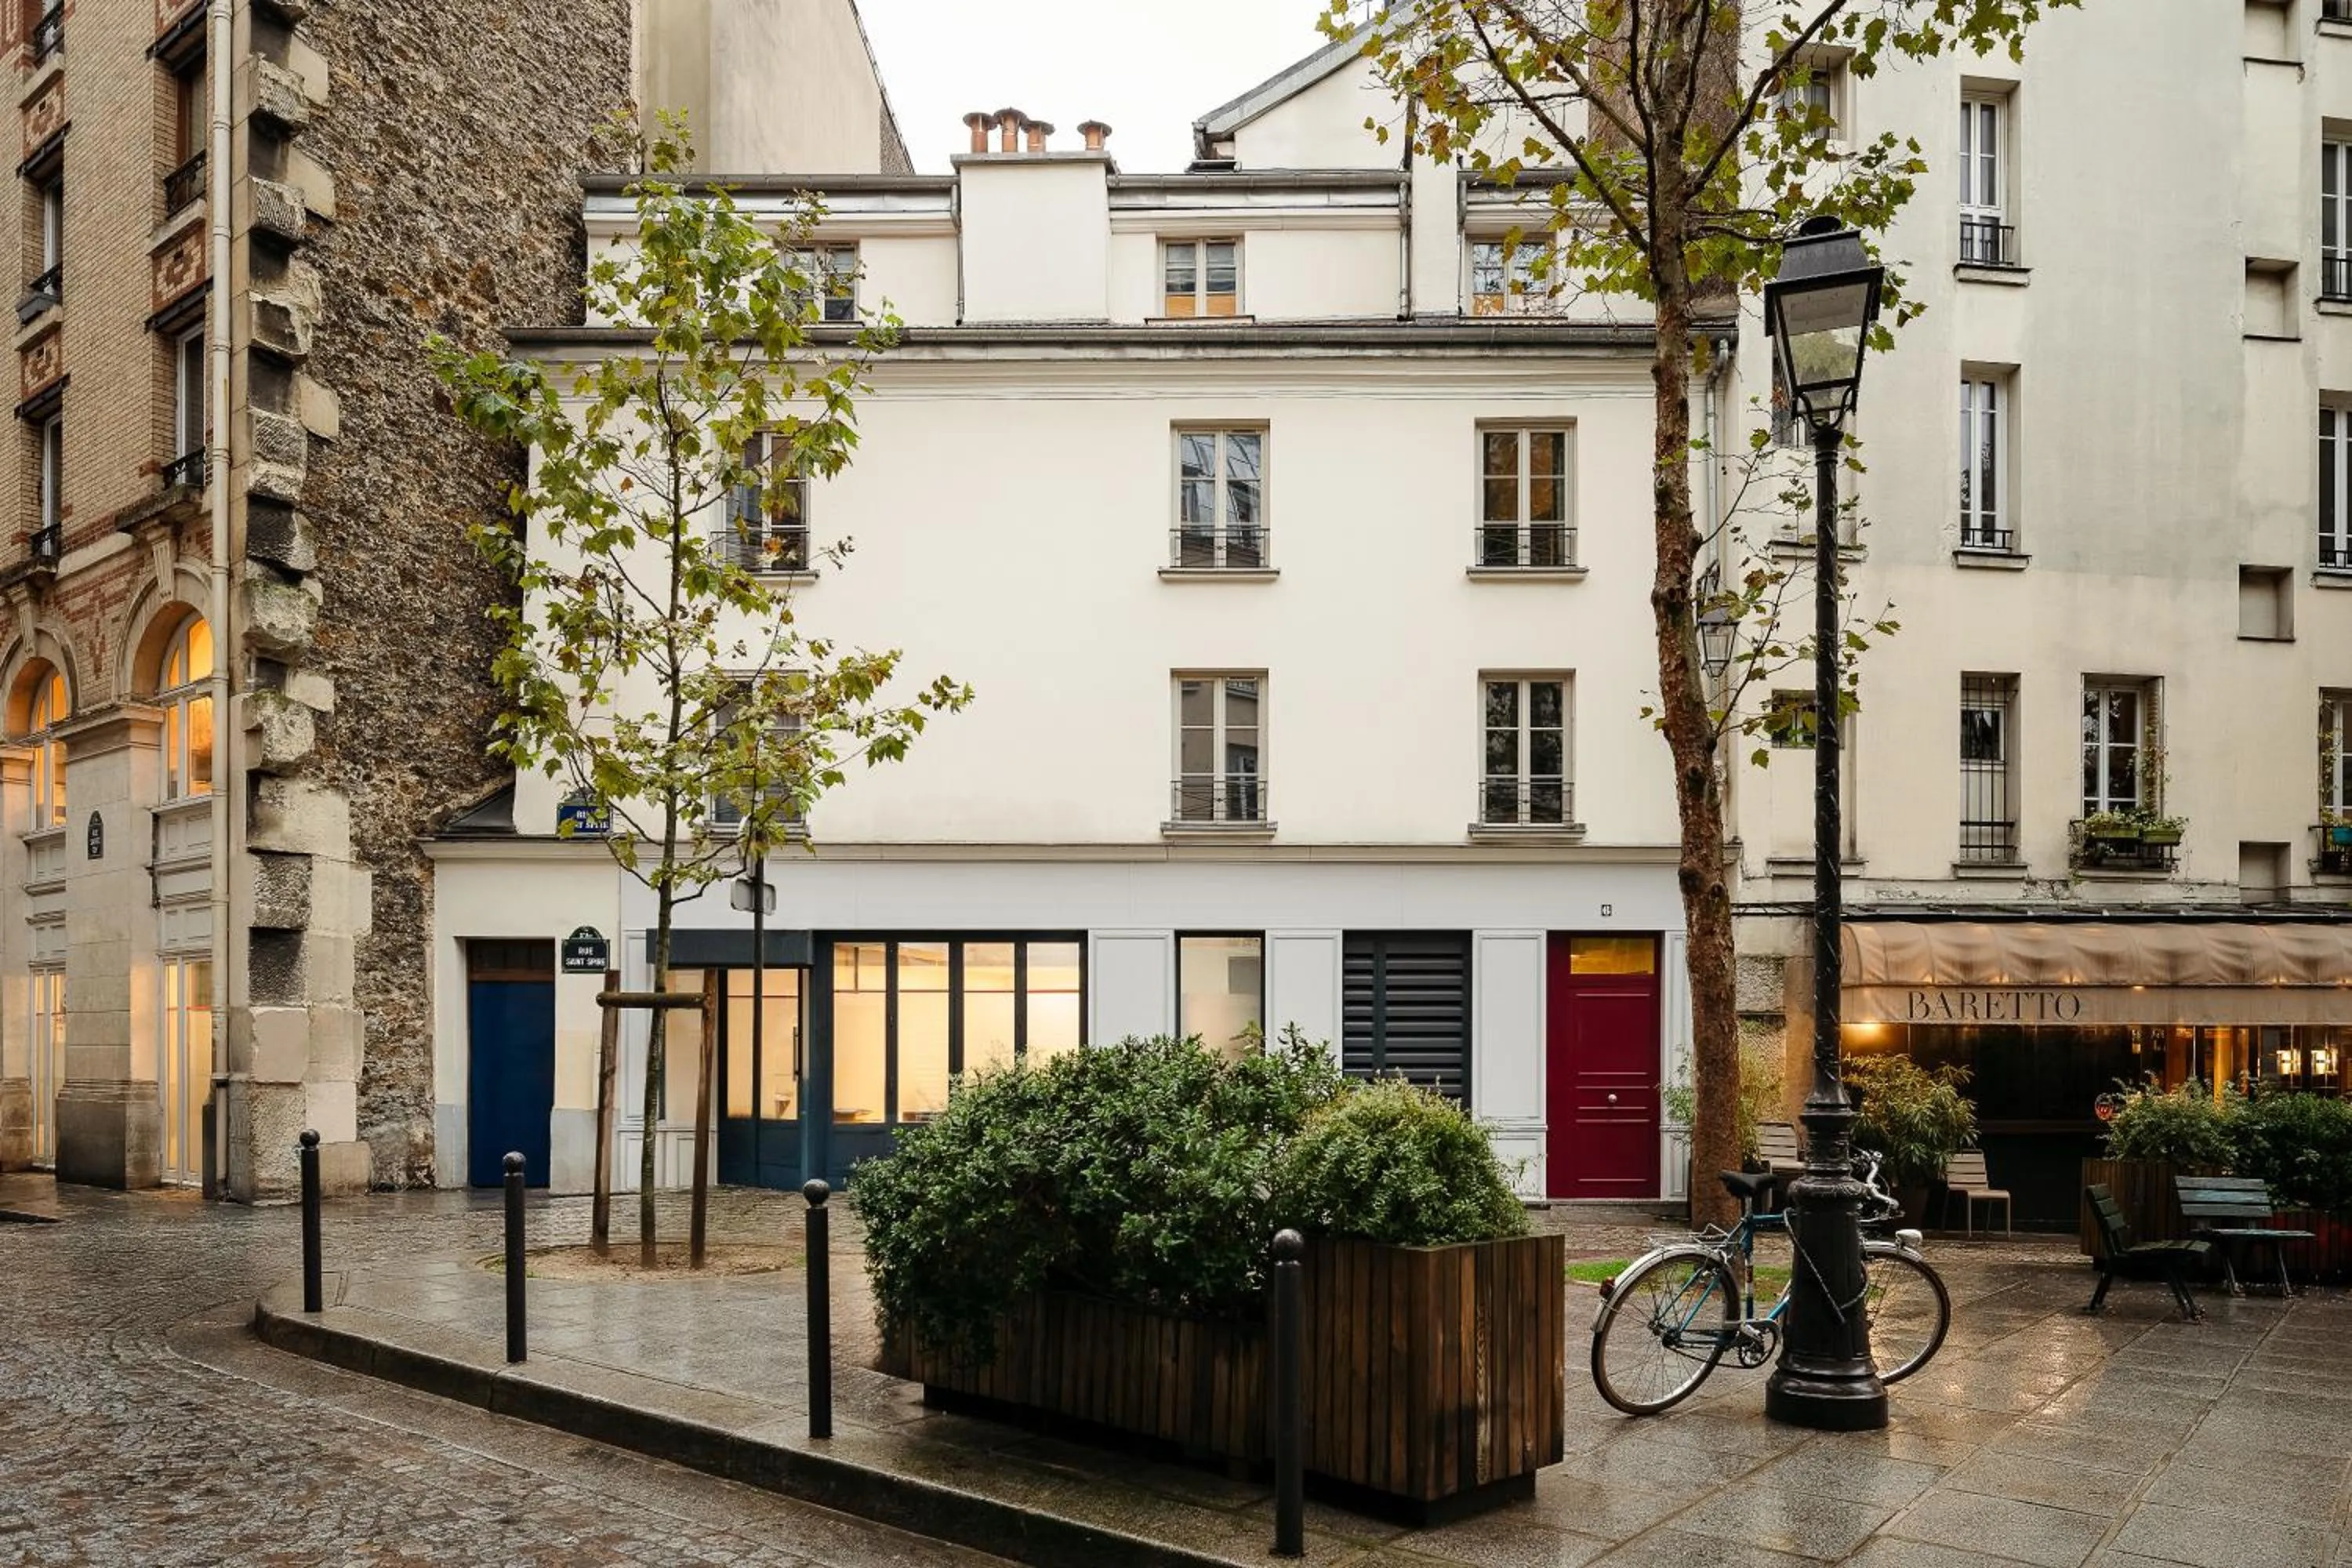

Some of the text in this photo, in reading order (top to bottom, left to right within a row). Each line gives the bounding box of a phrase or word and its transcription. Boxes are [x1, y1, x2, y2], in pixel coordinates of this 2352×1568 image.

[578, 946, 593, 956] RUE
[565, 957, 606, 967] SAINT SPIRE
[1907, 991, 2081, 1020] BARETTO
